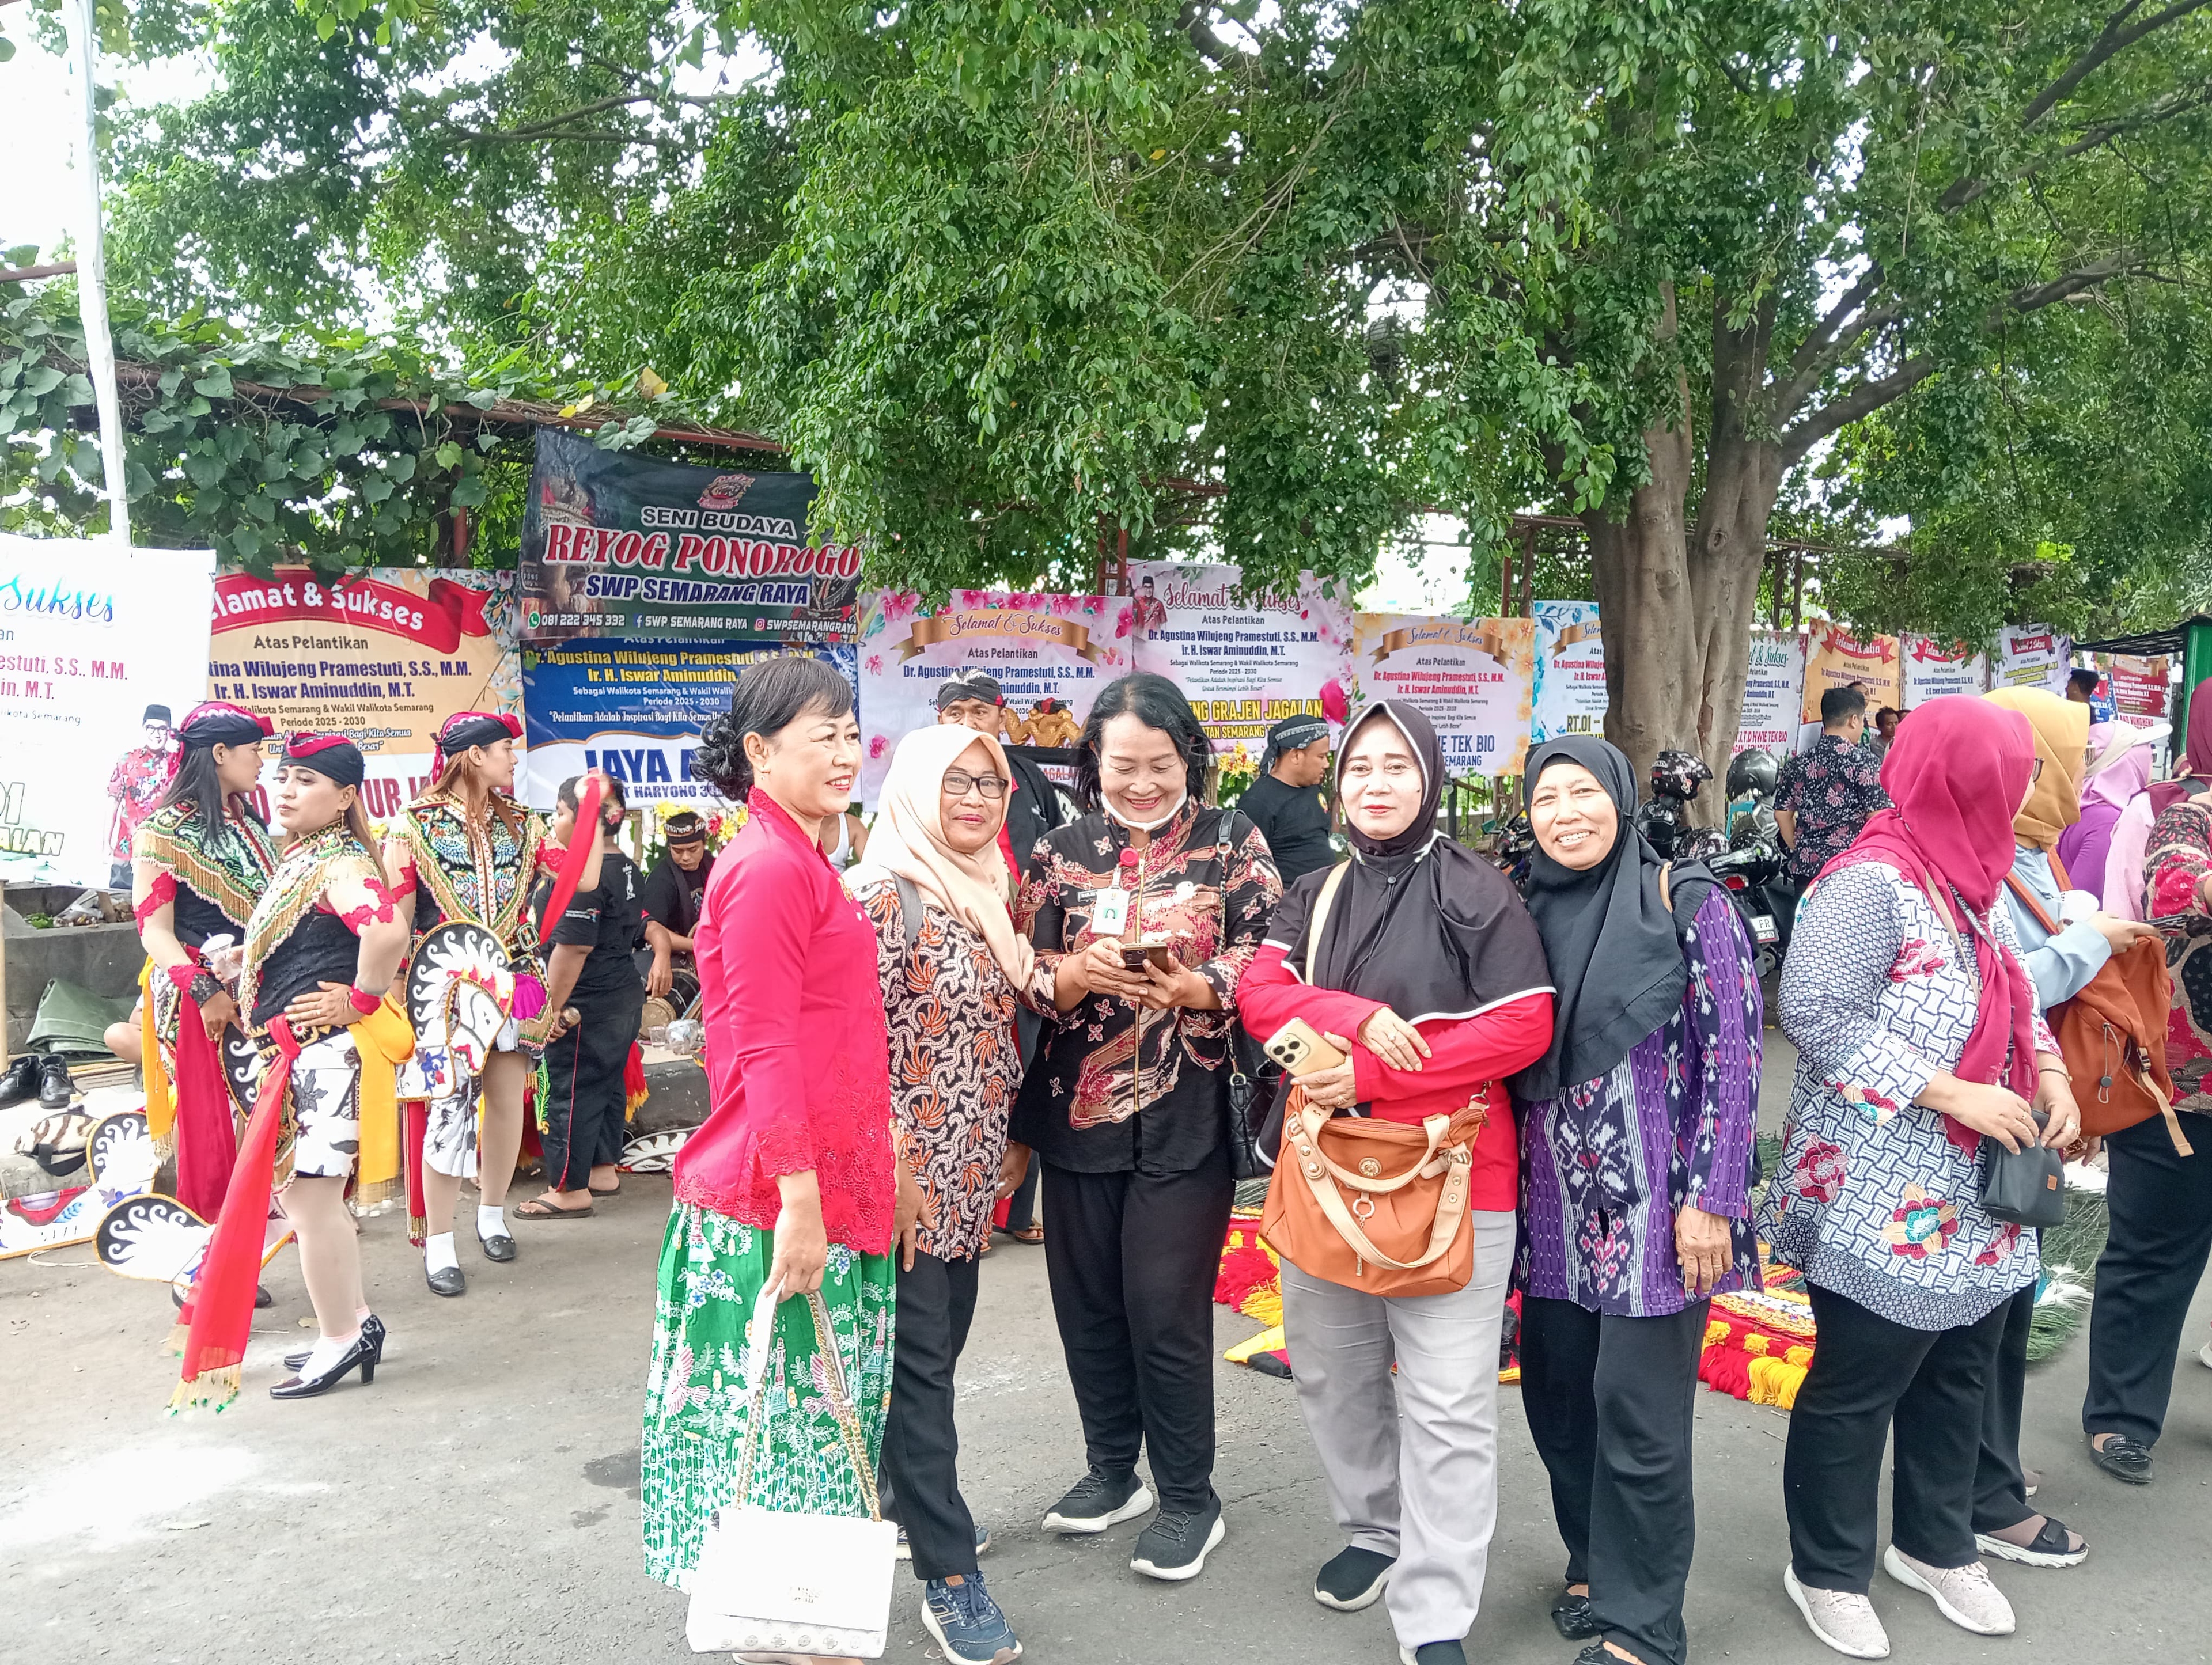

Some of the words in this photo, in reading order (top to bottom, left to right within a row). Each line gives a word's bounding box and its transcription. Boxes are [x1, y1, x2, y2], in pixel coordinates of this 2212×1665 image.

[642, 507, 697, 527] SENI
[702, 511, 795, 538] BUDAYA
[544, 524, 669, 569] REYOG
[673, 535, 861, 578] PONOROGO
[586, 574, 639, 598] SWP
[642, 578, 757, 604] SEMARANG
[759, 583, 809, 605] RAYA
[1164, 582, 1230, 608] Selamat
[0, 573, 113, 622] Sukses
[211, 582, 297, 620] lamat
[304, 582, 323, 607] &
[331, 584, 423, 631] Sukses
[541, 615, 558, 626] 081
[559, 614, 580, 626] 222
[582, 614, 604, 626] 345
[605, 614, 625, 626] 332
[645, 616, 668, 627] SWP
[671, 616, 723, 629] SEMARANG
[725, 617, 748, 630] RAYA
[767, 619, 858, 634] SWPSEMARANGRAYA
[942, 614, 1003, 636] Selamat
[1004, 613, 1017, 632] &
[1017, 614, 1061, 636] Sukses
[1202, 616, 1221, 624] Atas
[1223, 616, 1264, 624] Pelantikan
[1149, 629, 1158, 640] Dr.
[1160, 630, 1195, 642] Agustina
[1197, 631, 1233, 642] Wilujeng
[1236, 631, 1282, 642] Pramestuti,
[1283, 632, 1300, 642] S.S.,
[1301, 632, 1319, 642] M.M.
[1407, 627, 1444, 644] Selamat
[1454, 628, 1483, 645] Sukses
[253, 635, 289, 649] Atas
[292, 636, 368, 650] Pelantikan
[968, 648, 989, 658] Atas
[991, 648, 1038, 659] Pelantikan
[1191, 645, 1198, 655] H.
[1200, 645, 1222, 655] Iswar
[1224, 645, 1268, 656] Aminuddin,
[1271, 646, 1286, 655] M.T.
[1590, 647, 1602, 655] Atas
[1756, 646, 1764, 663] &
[547, 651, 612, 665] Agustina
[614, 651, 677, 666] Wilujeng
[1416, 657, 1432, 666] Atas
[1433, 657, 1465, 666] Pelantikan
[1562, 660, 1585, 670] Agustina
[91, 661, 128, 680] M.M.
[243, 661, 316, 678] Wilujeng
[320, 661, 406, 678] Pramestuti,
[408, 661, 438, 678] S.S.,
[440, 661, 472, 676] M.M.
[588, 668, 602, 682] Ir.
[604, 668, 618, 682] H.
[620, 668, 660, 682] Iswar
[903, 666, 916, 677] Dr.
[1006, 666, 1056, 679] Pramestuti,
[1058, 667, 1074, 679] S.S.,
[1076, 667, 1095, 678] M.M.
[1586, 672, 1601, 680] Iswar
[1382, 671, 1410, 681] Agustina
[1411, 672, 1441, 682] Wilujeng
[1442, 672, 1476, 682] Pramestuti,
[1491, 673, 1504, 682] M.M.
[25, 681, 54, 699] M.T.
[214, 683, 231, 699] Ir.
[233, 683, 249, 699] H.
[251, 683, 297, 699] Iswar
[300, 682, 385, 699] Aminuddin,
[388, 682, 415, 697] M.T.
[573, 687, 606, 696] Sebagai
[607, 687, 641, 695] Walikota
[643, 687, 681, 696] Semarang
[689, 687, 711, 695] Wakil
[999, 682, 1042, 695] inuddin,
[1044, 682, 1059, 694] M.T.
[1412, 685, 1430, 694] Iswar
[1431, 685, 1467, 695] Aminuddin,
[1468, 685, 1479, 694] M.T.
[675, 698, 694, 706] 2025
[700, 698, 719, 706] 2030
[279, 704, 321, 715] Semarang
[323, 705, 329, 713] &
[332, 704, 355, 712] Wakil
[357, 704, 392, 712] Walikota
[393, 703, 434, 713] Semarang
[1211, 700, 1262, 721] GRAJEN
[1264, 699, 1324, 720] JAGALAN
[32, 710, 81, 726] Semarang
[281, 718, 313, 726] Periode
[315, 717, 337, 726] 2025
[344, 717, 365, 726] 2030
[594, 711, 620, 722] Adalah
[655, 711, 671, 723] Bagi
[689, 711, 712, 722] Semua
[348, 729, 368, 738] Bagi
[368, 729, 385, 738] Kita
[385, 727, 412, 738] Semua
[1222, 725, 1266, 739] SEMARANG
[1768, 730, 1778, 742] TEK
[1450, 735, 1472, 752] TEK
[1476, 735, 1495, 752] BIO
[1445, 755, 1482, 767] EMARANG
[633, 785, 698, 798] HARYONO
[1759, 919, 1770, 928] FR
